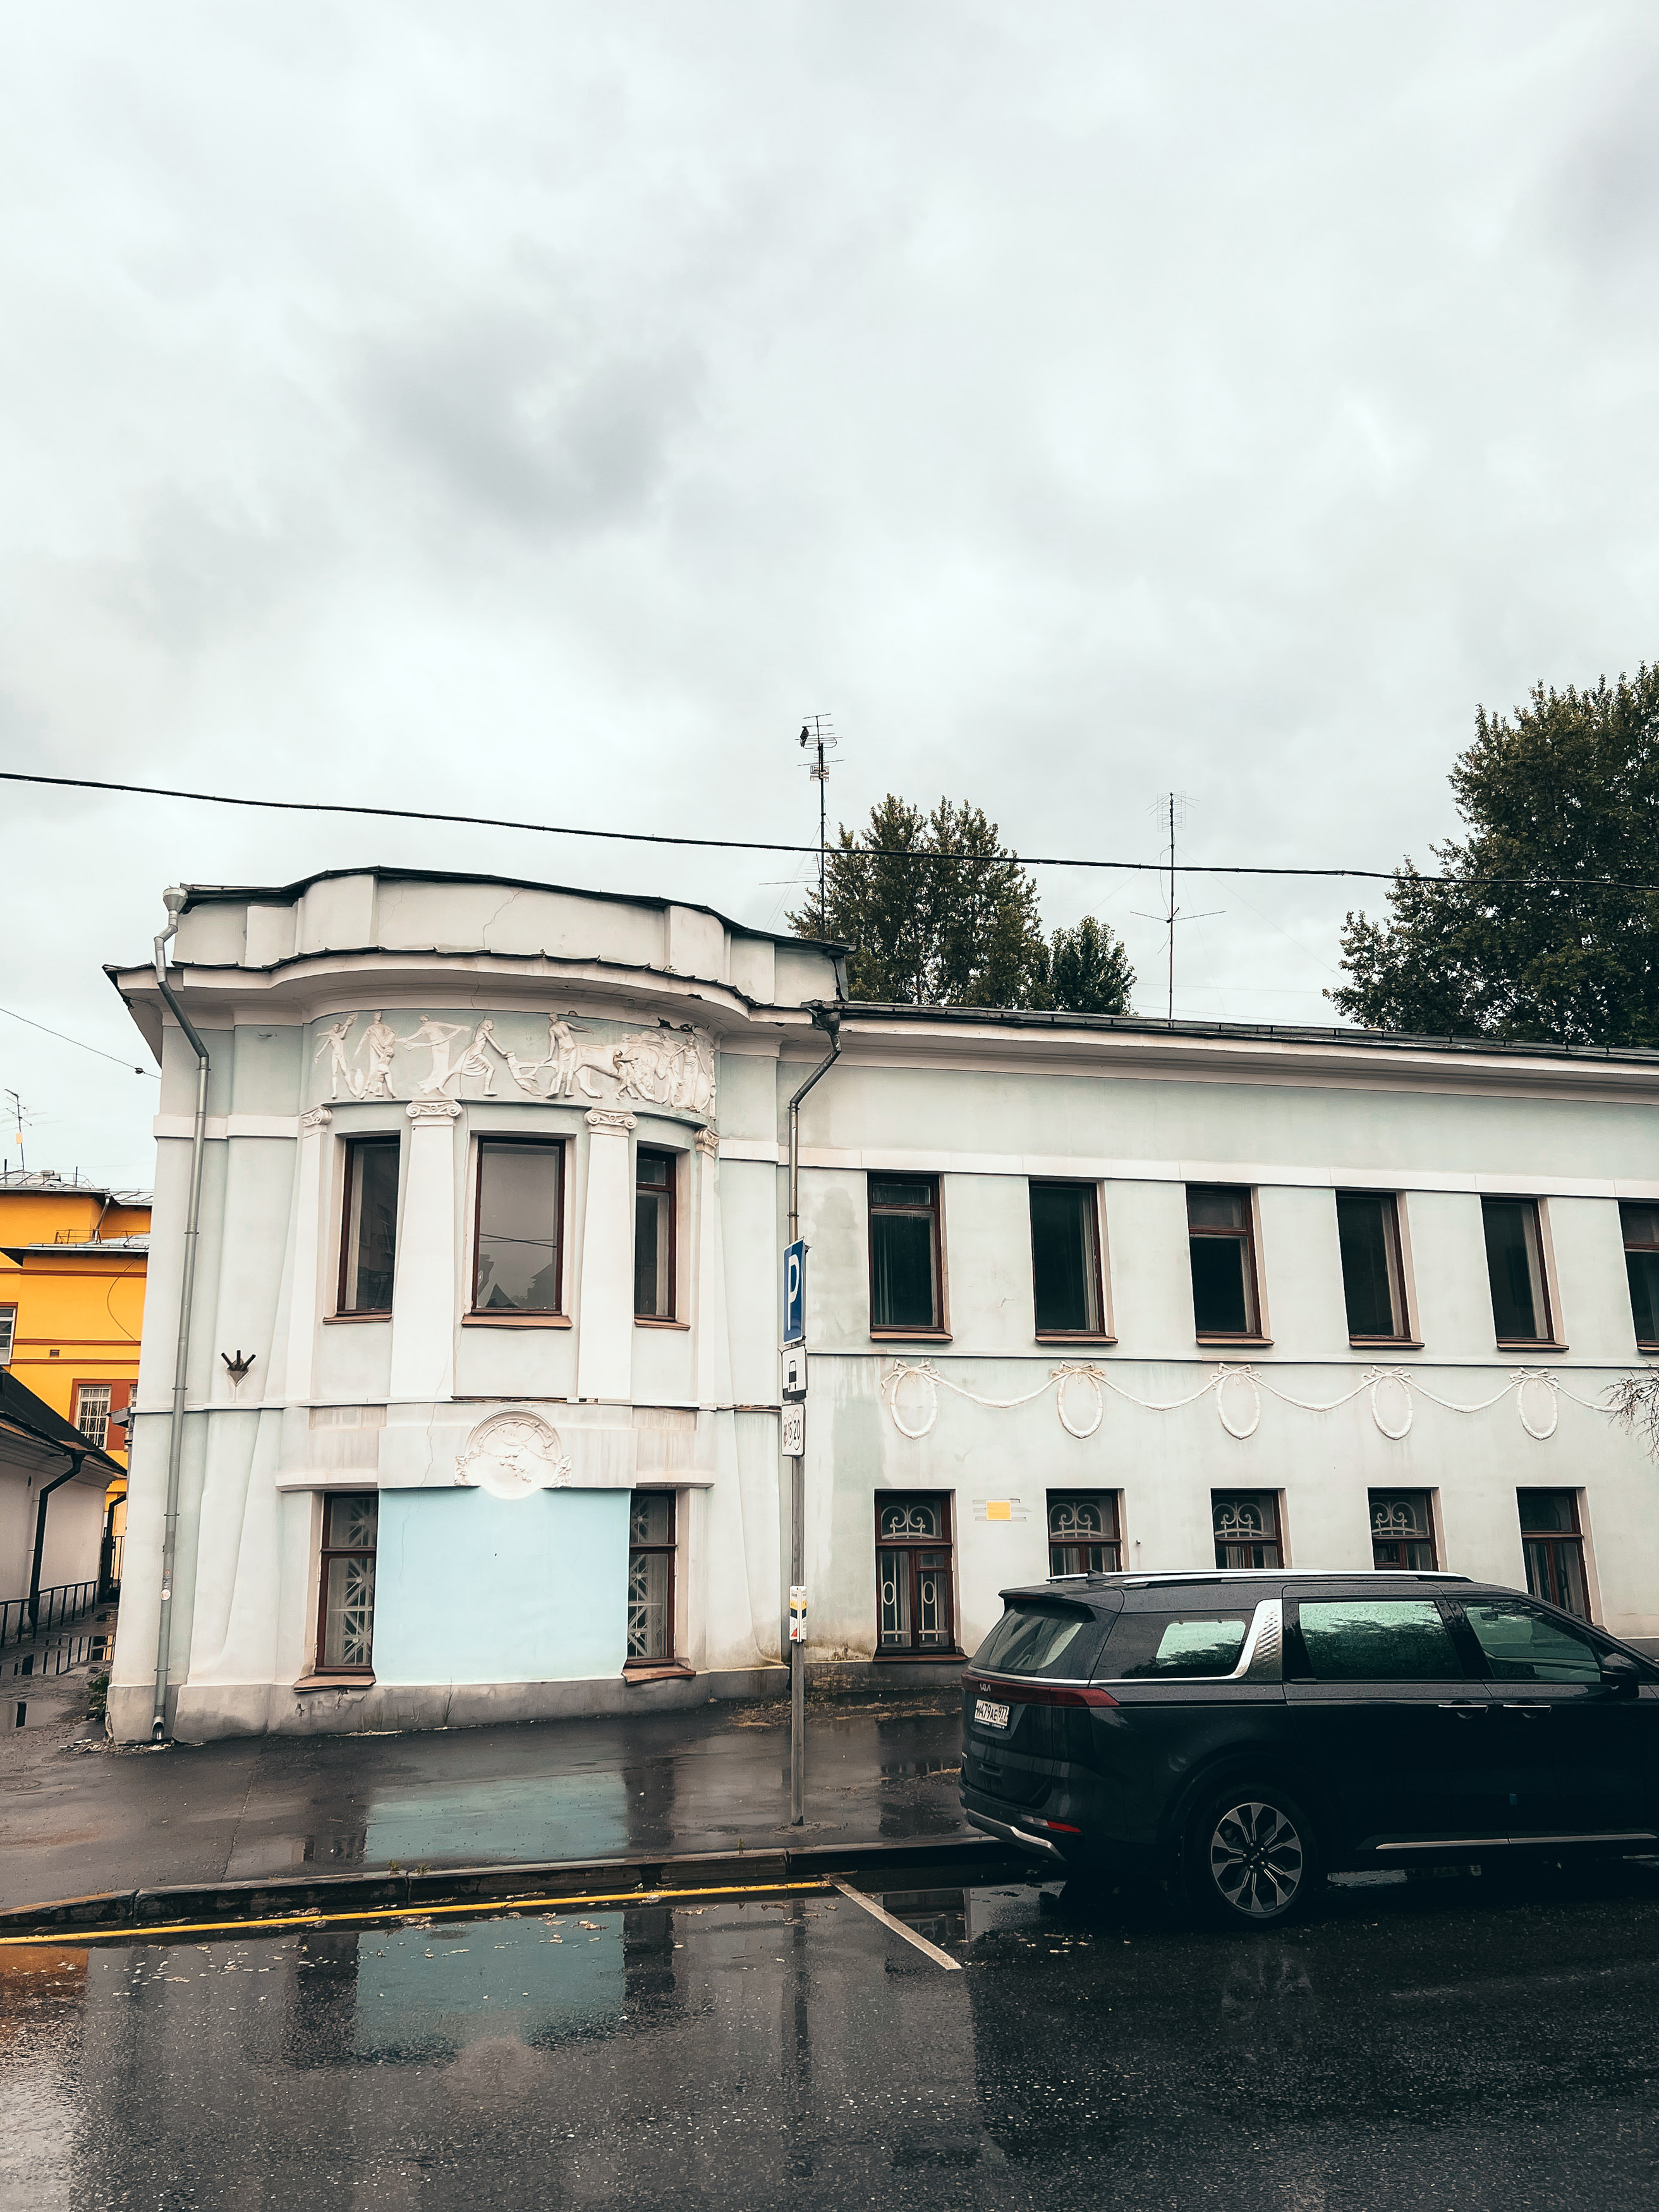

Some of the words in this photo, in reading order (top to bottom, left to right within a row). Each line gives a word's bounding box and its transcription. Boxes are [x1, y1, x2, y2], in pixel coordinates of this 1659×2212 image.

[787, 1253, 799, 1331] P
[793, 1419, 801, 1440] 20
[980, 1683, 991, 1692] KIA
